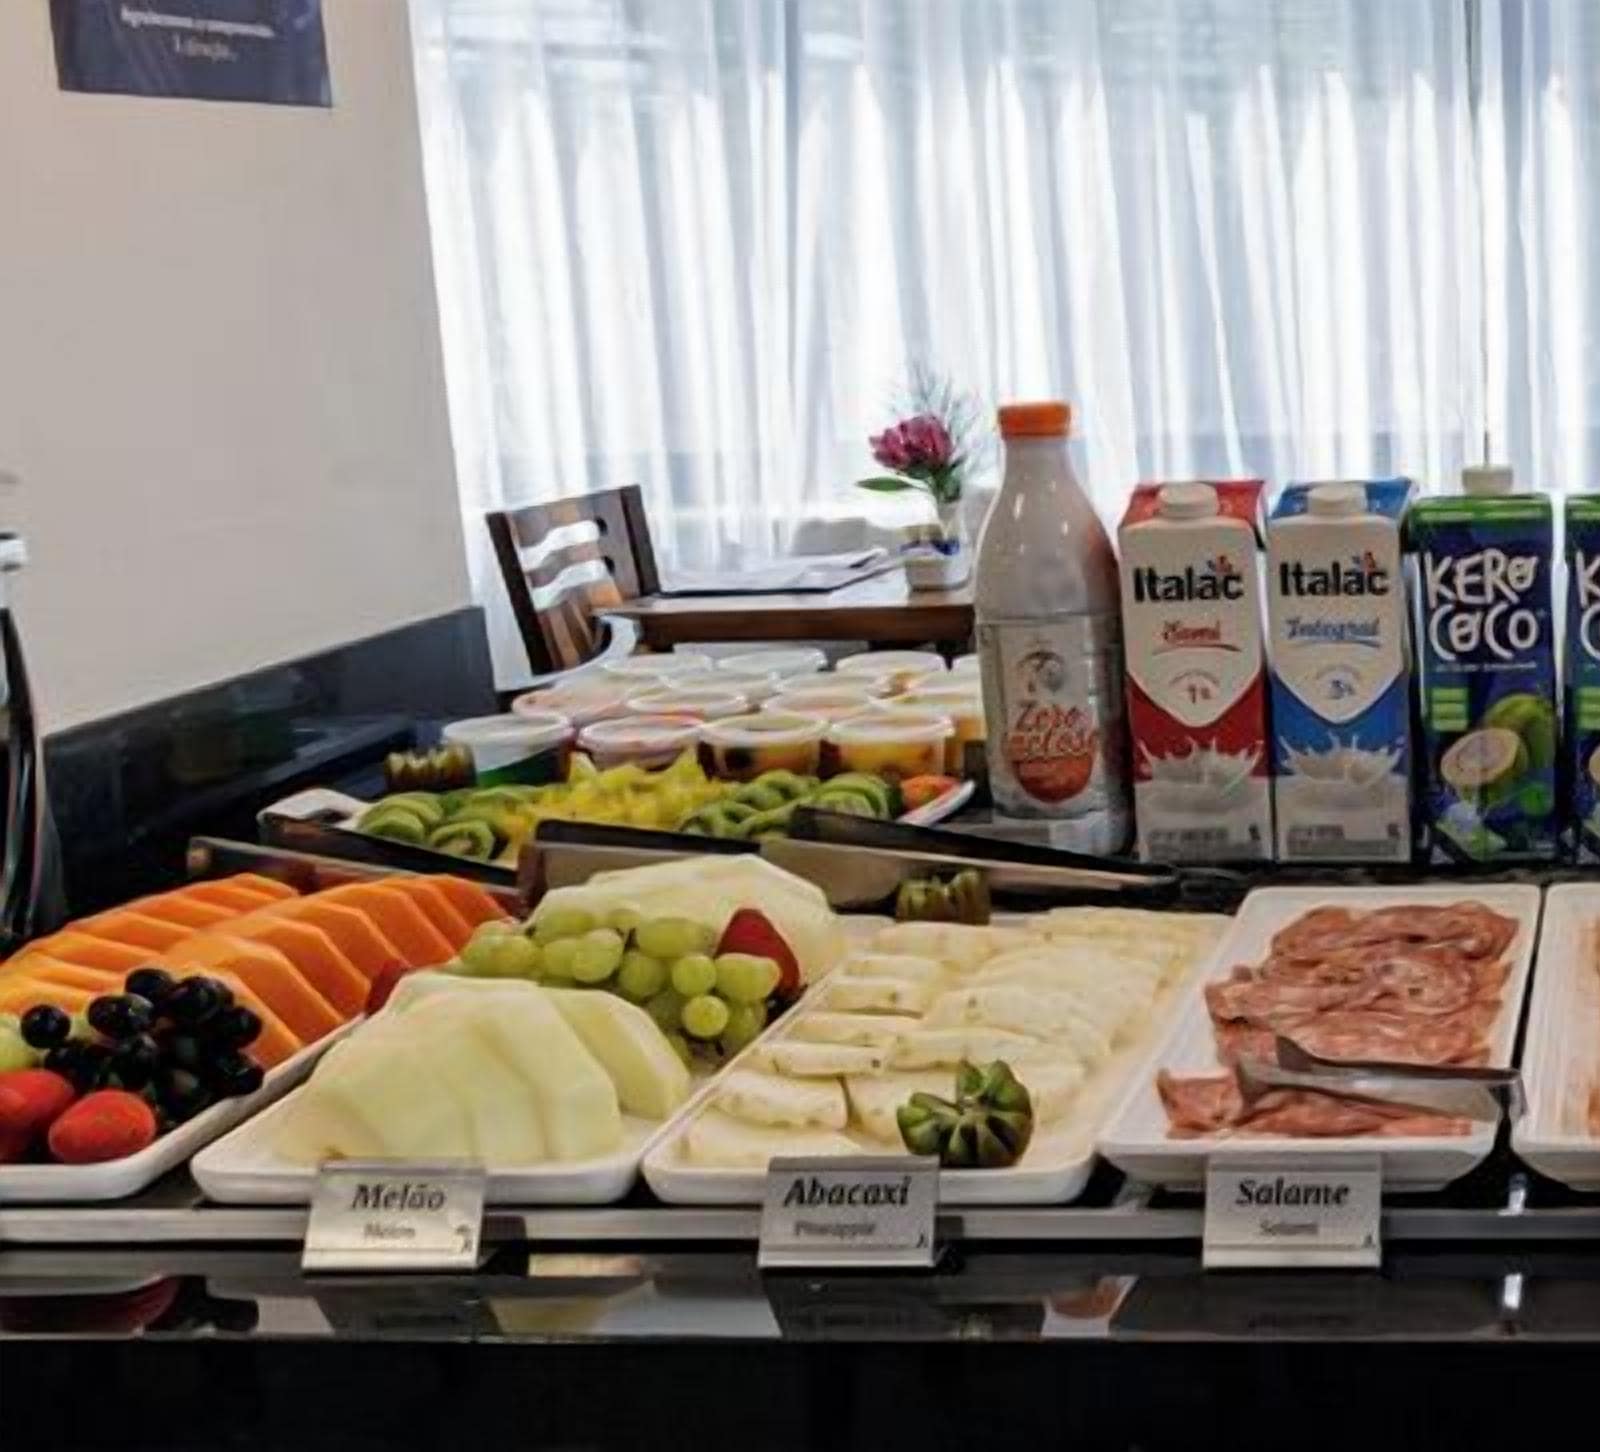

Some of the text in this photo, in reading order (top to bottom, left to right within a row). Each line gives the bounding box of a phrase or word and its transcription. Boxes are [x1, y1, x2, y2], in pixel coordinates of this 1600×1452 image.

[1134, 563, 1244, 603] Italac
[1279, 560, 1389, 597] Italac
[1424, 548, 1539, 609] KERO
[1430, 602, 1538, 661] COCO
[352, 1182, 446, 1212] Melão
[784, 1175, 912, 1207] Abacaxi
[1235, 1176, 1349, 1206] Salame
